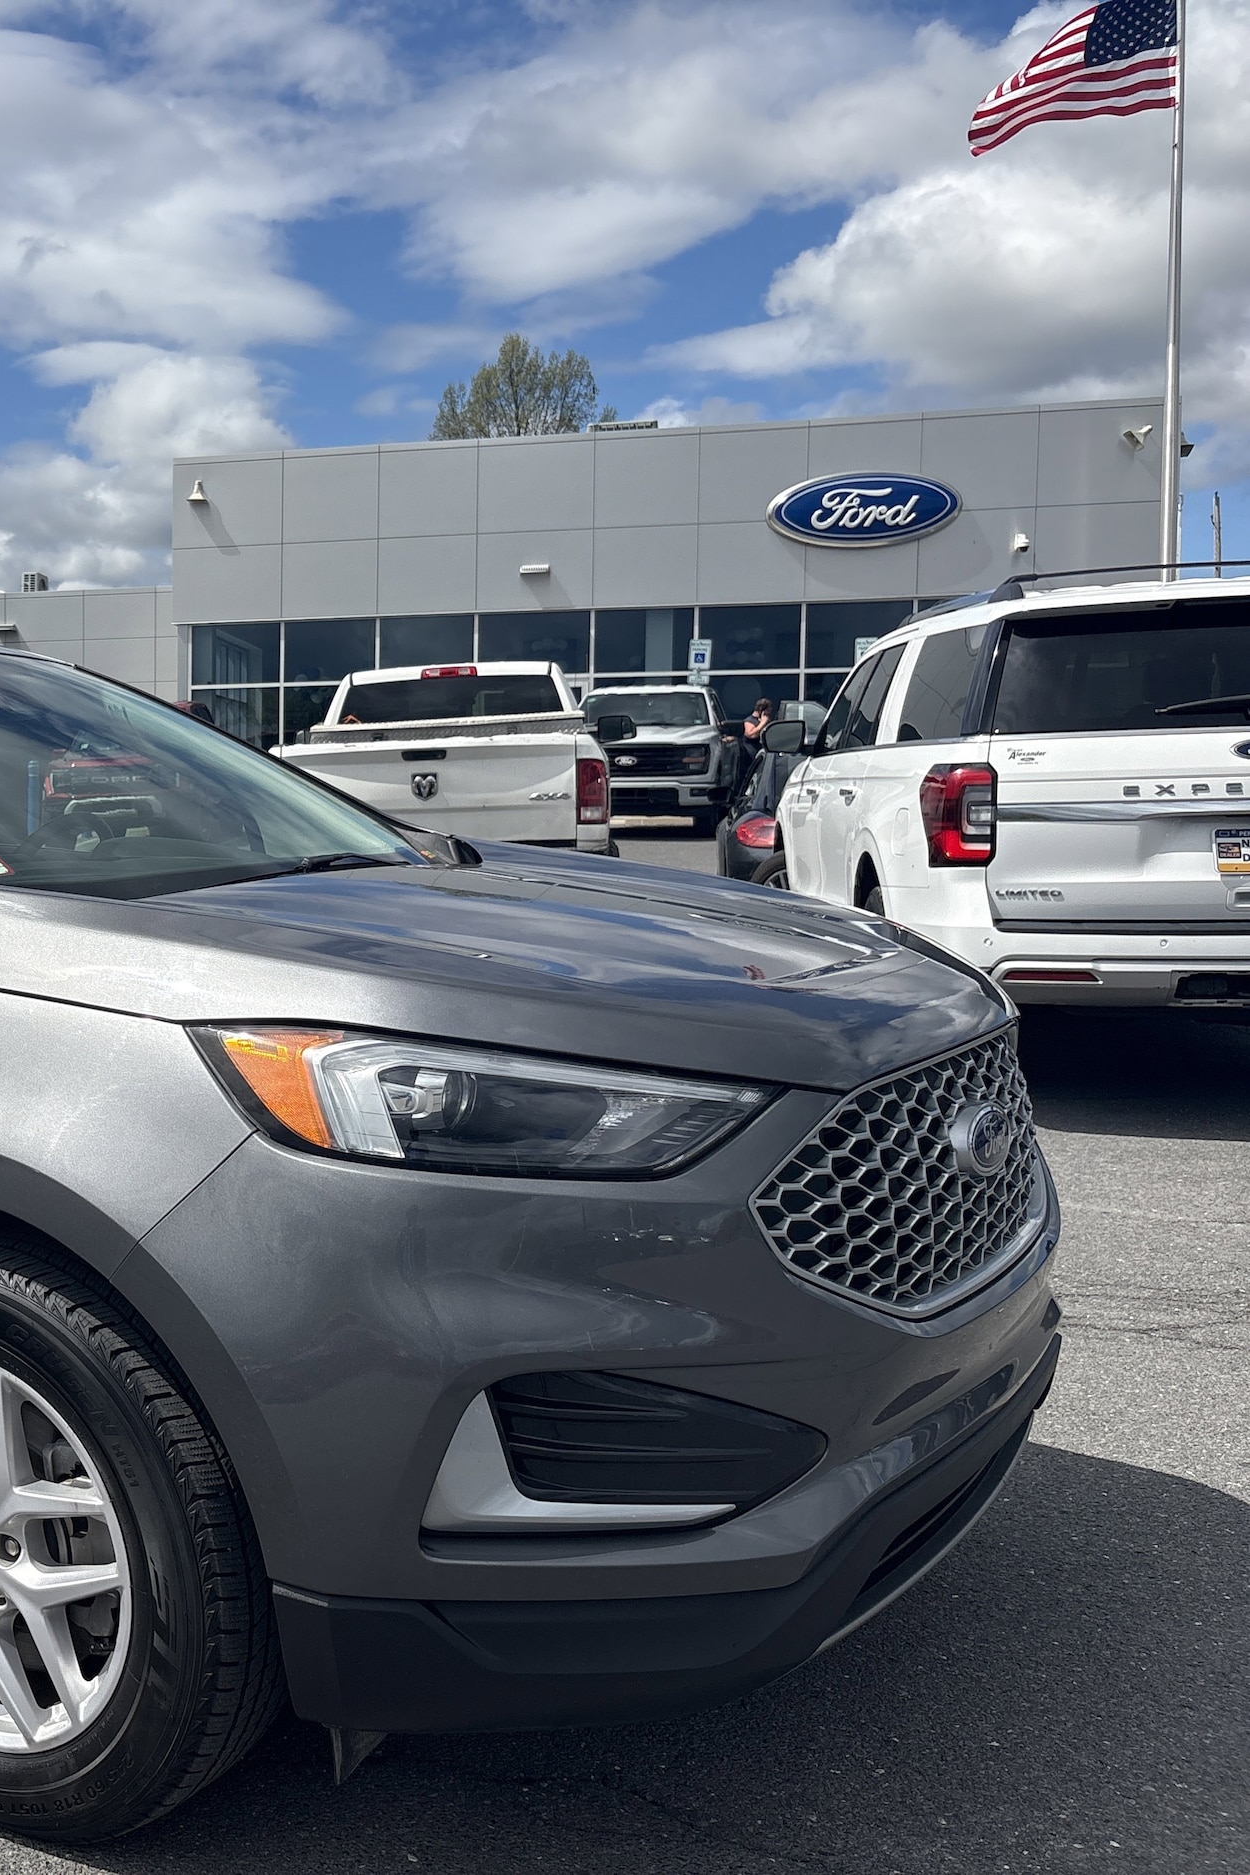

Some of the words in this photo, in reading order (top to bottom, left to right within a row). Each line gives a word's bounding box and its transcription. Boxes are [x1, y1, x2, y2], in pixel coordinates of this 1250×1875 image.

[810, 487, 920, 530] Ford
[1008, 751, 1047, 760] Alexander
[1123, 783, 1244, 798] EXPE
[995, 889, 1064, 900] LIMITED
[111, 1443, 139, 1488] HT51
[9, 1802, 49, 1817] 105T
[52, 1791, 85, 1814] R18
